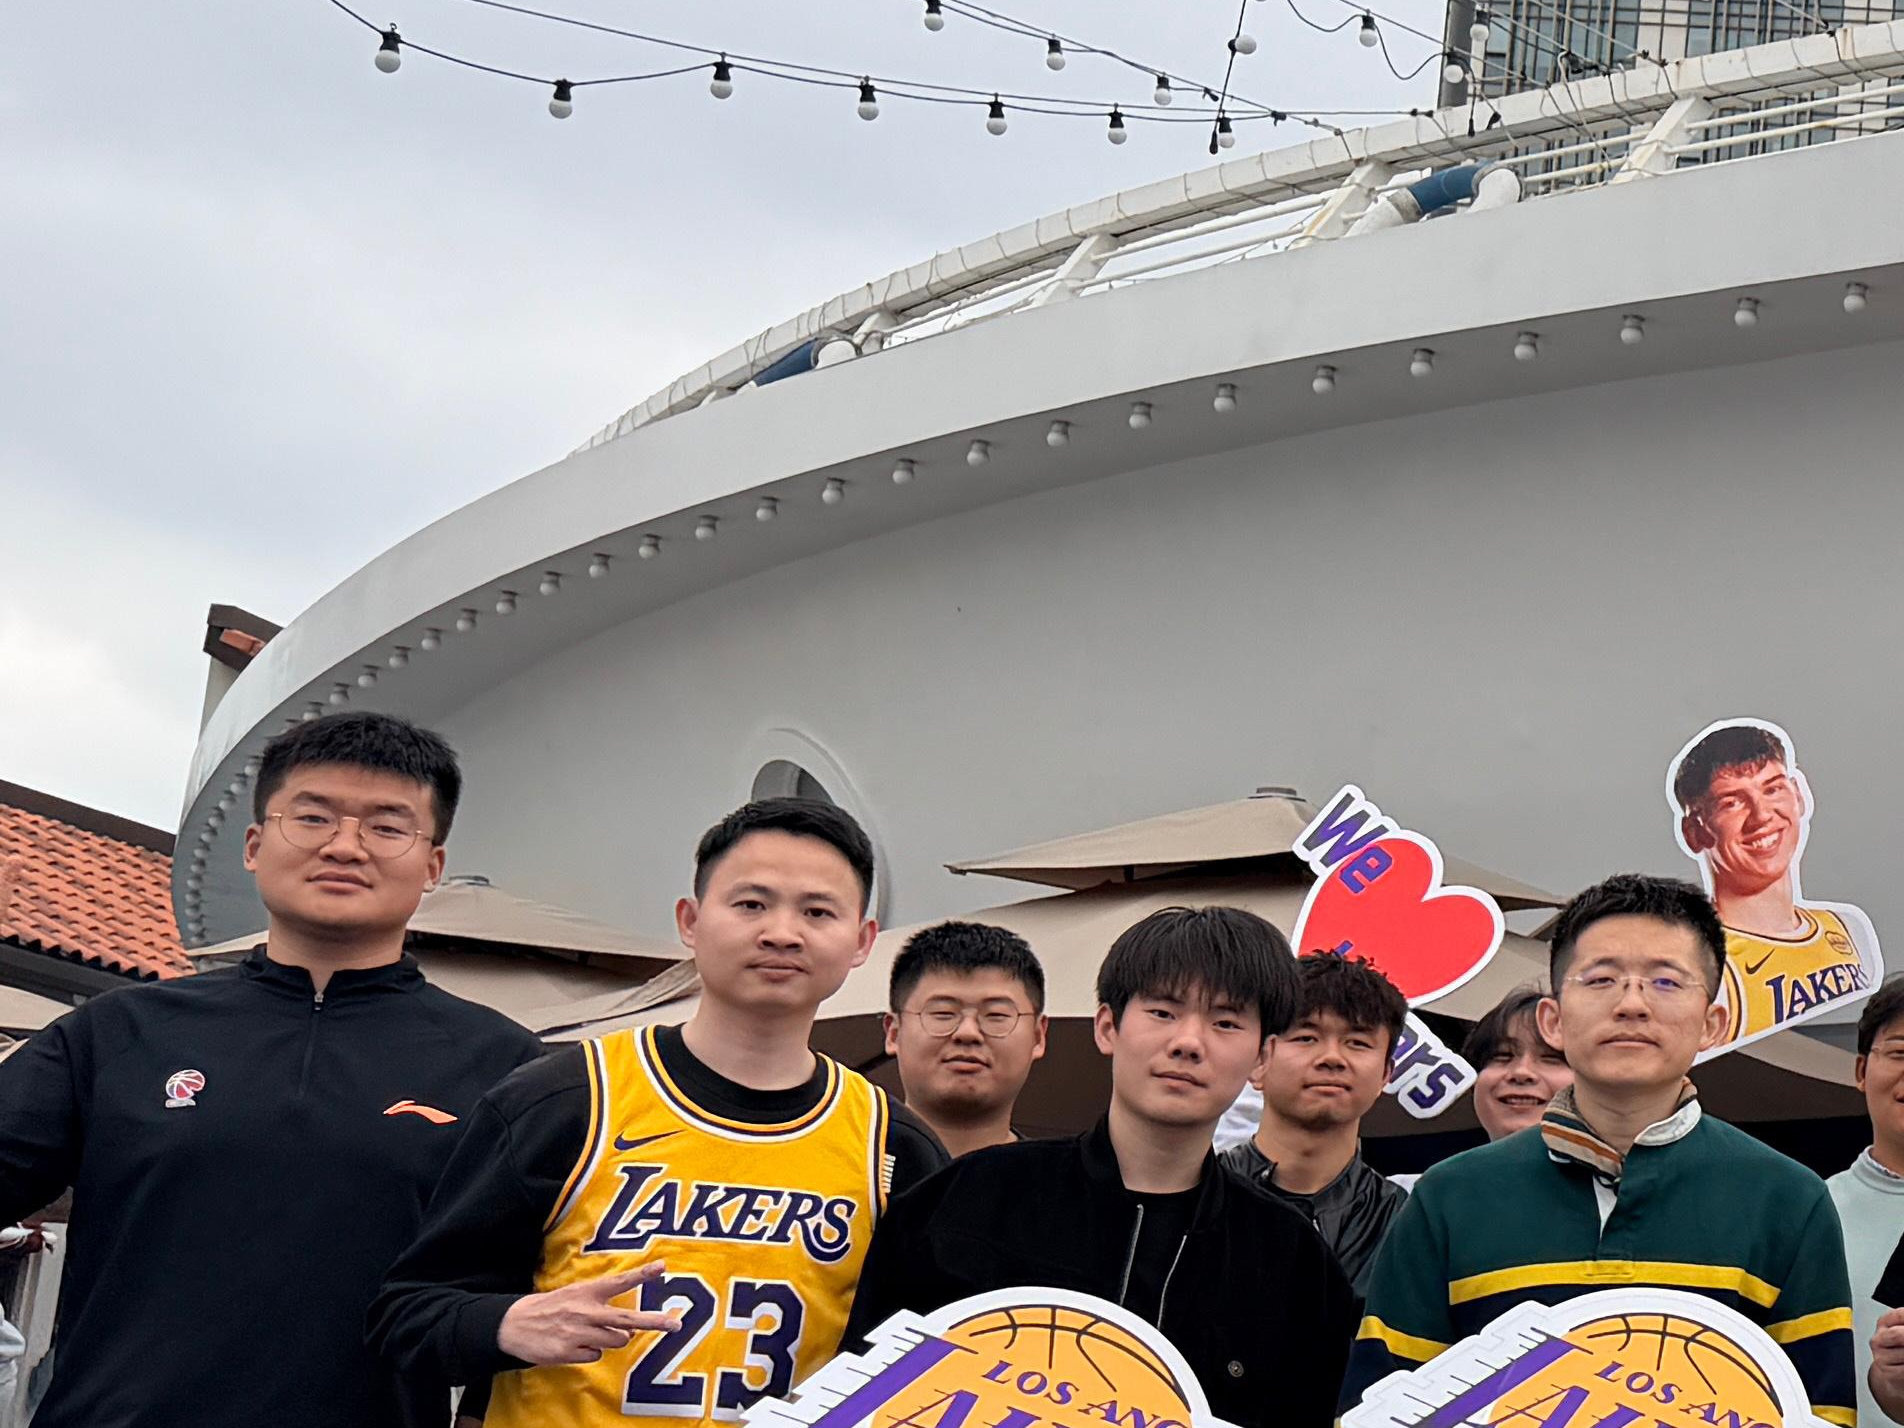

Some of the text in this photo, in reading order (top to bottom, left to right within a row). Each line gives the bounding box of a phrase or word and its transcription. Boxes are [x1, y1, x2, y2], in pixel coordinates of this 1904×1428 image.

[1302, 791, 1394, 895] We
[581, 1164, 857, 1265] LAKERS
[621, 1272, 806, 1422] 23
[982, 1360, 1080, 1406] LOS
[1594, 1361, 1683, 1405] LOS
